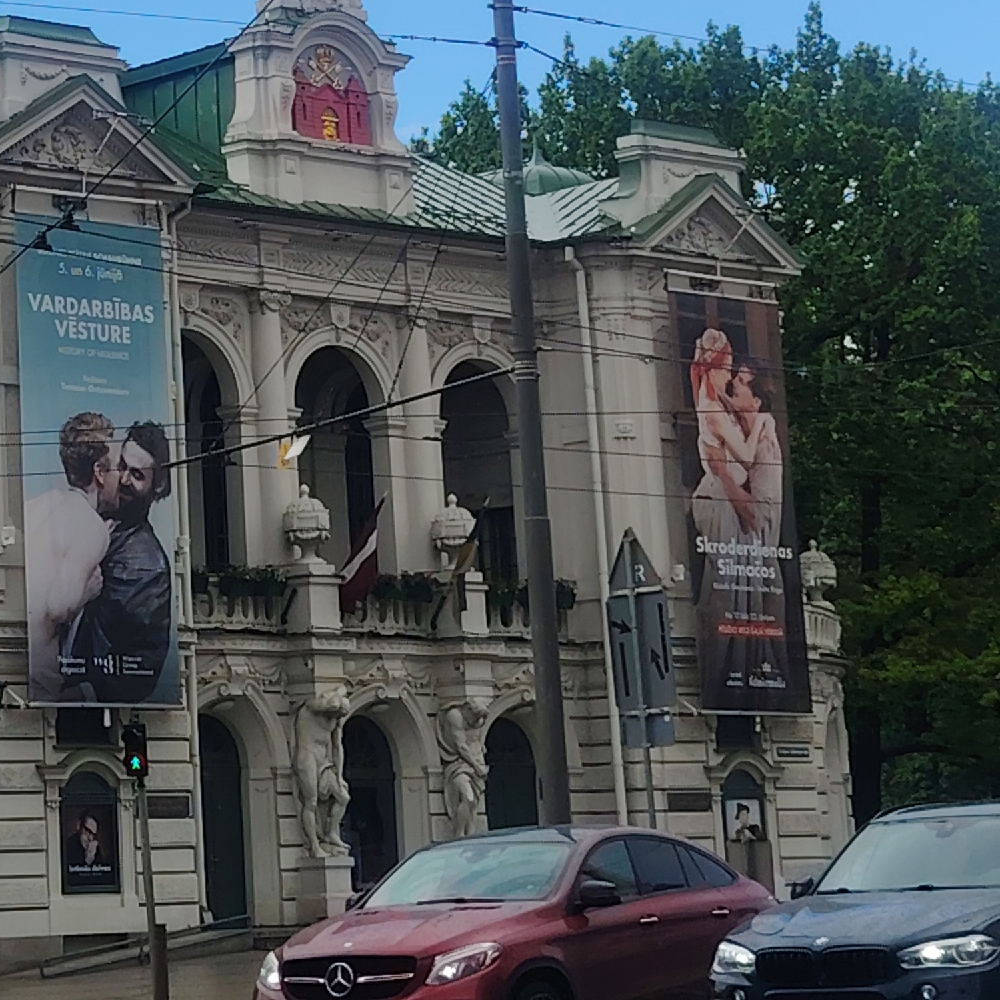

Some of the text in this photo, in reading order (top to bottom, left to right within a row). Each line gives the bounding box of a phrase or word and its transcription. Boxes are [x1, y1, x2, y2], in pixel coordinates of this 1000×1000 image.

[58, 262, 69, 275] 5.
[84, 265, 95, 278] 6.
[27, 292, 154, 324] VARDARBĪBAS
[54, 318, 132, 344] VĒSTURE
[695, 535, 794, 560] Skroderdienas
[634, 564, 646, 582] R
[716, 558, 776, 580] Silmačos
